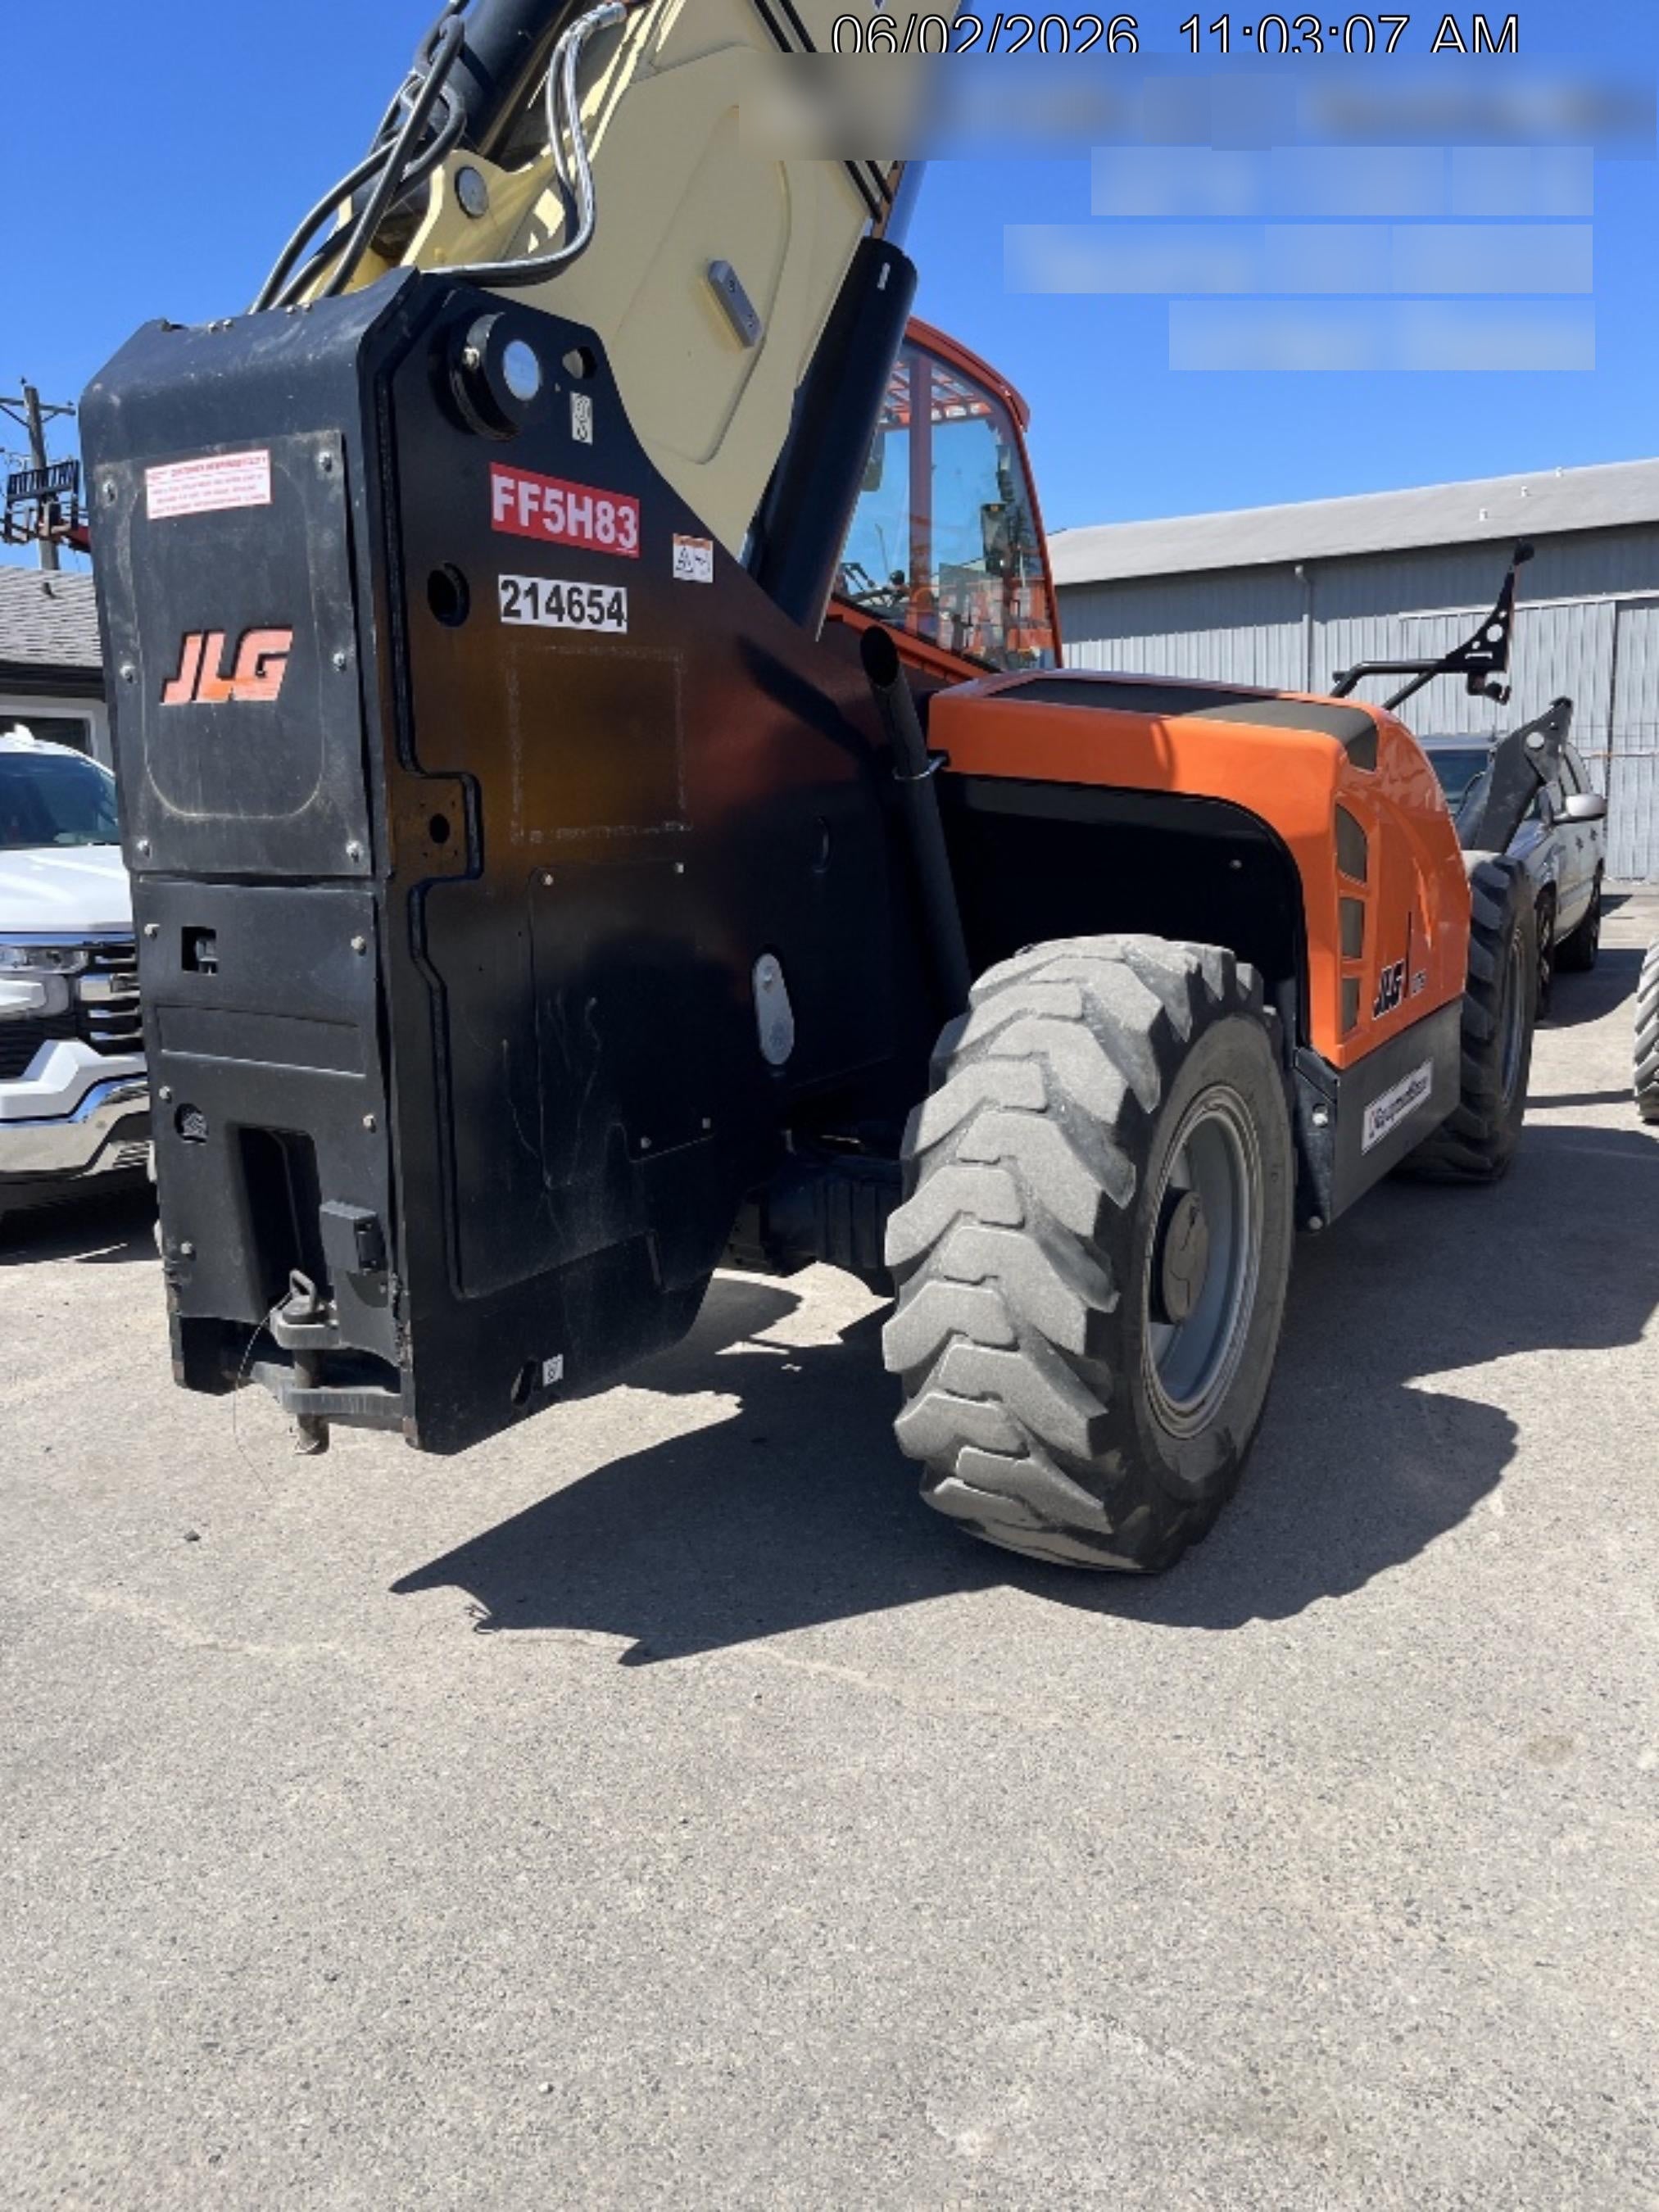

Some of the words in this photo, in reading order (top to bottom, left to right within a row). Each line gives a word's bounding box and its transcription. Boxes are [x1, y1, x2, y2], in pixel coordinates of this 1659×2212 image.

[492, 473, 637, 549] FF5H83
[501, 579, 625, 628] 214654
[161, 625, 293, 705] JLG
